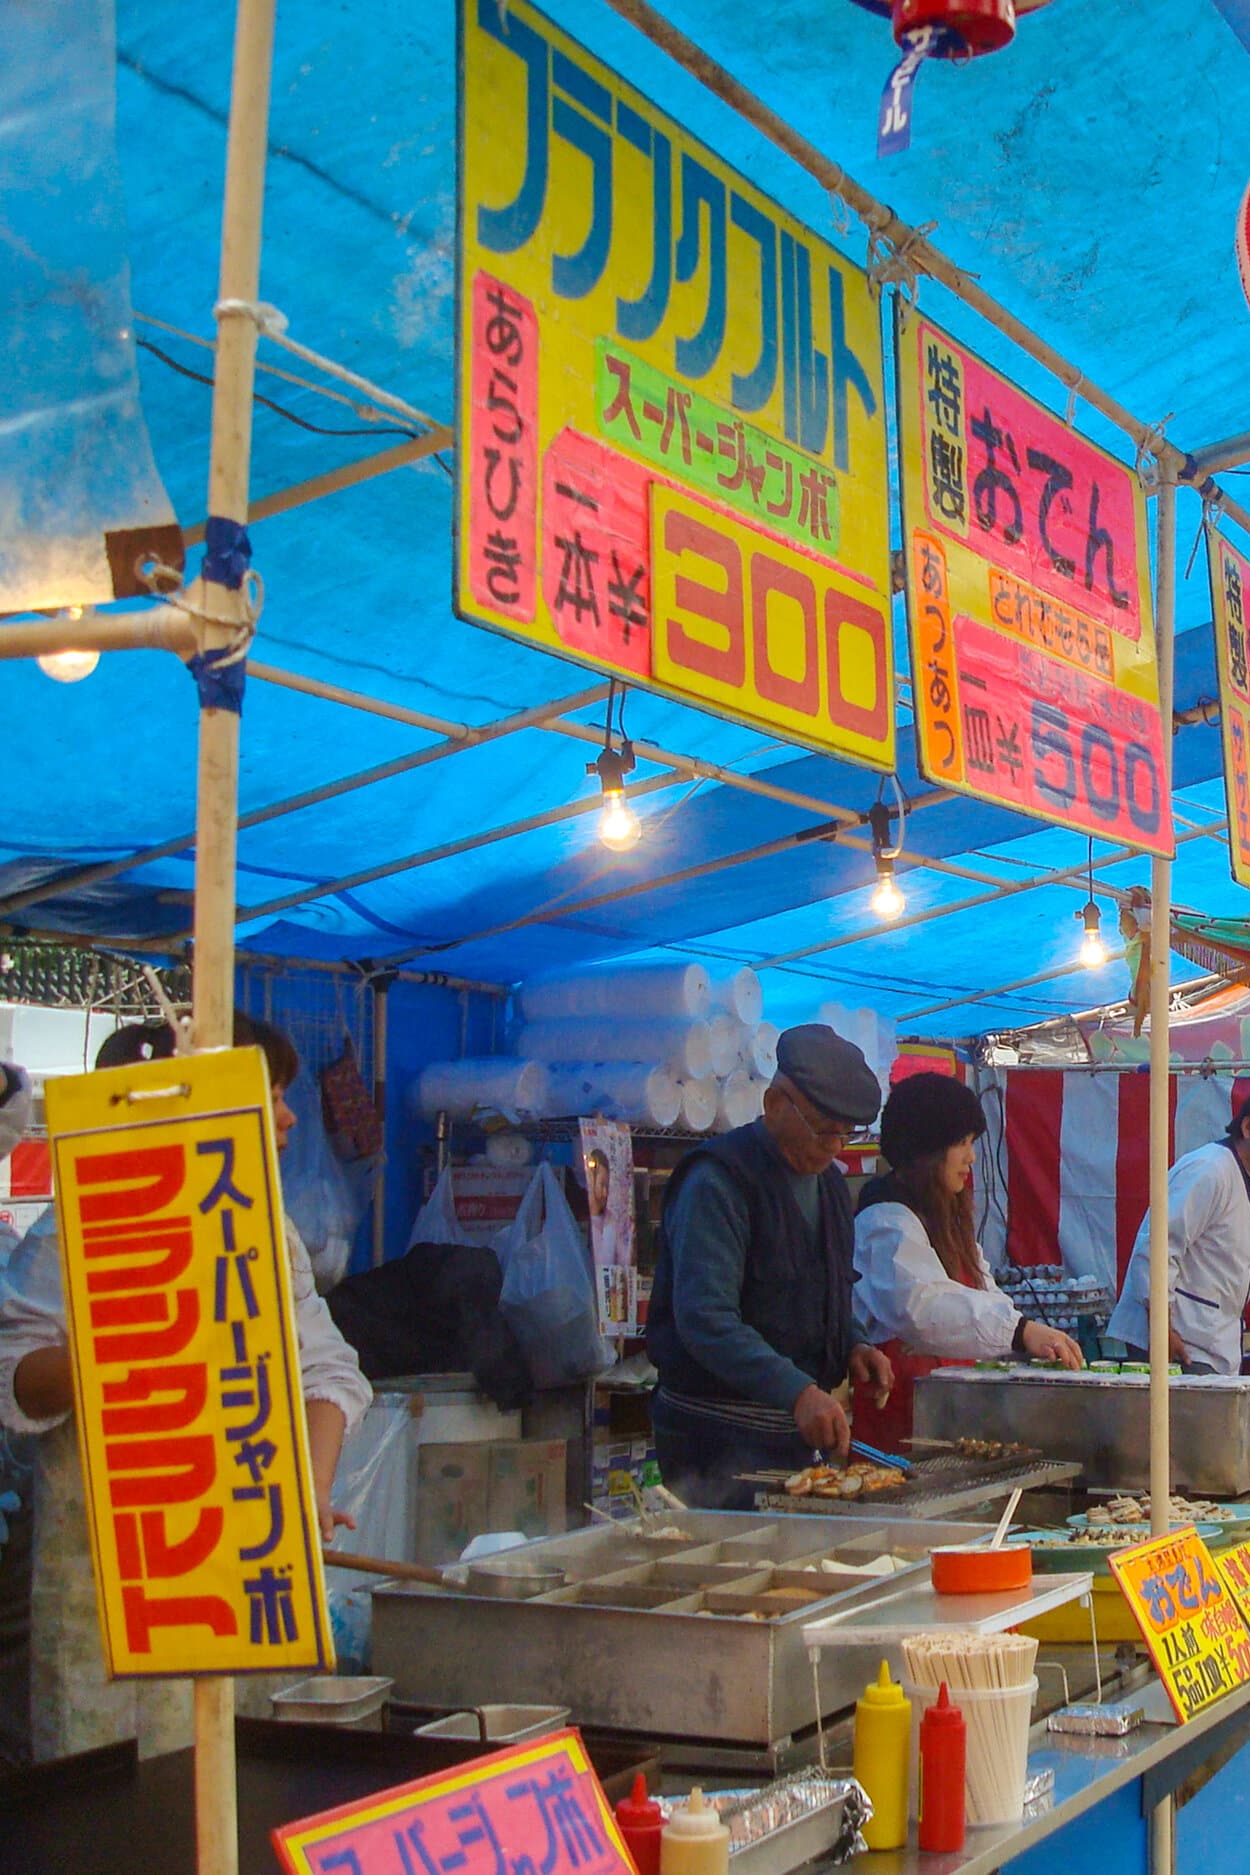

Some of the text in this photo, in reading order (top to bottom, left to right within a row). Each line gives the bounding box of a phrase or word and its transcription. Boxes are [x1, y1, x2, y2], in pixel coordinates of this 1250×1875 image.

[477, 2, 876, 472] フランクフルト
[483, 287, 525, 603] あらびき
[605, 355, 837, 541] スーパージャンボ
[927, 343, 967, 527] 特製
[970, 407, 1129, 609] おでん
[553, 484, 602, 628] 一本
[919, 541, 956, 768] あつあつ
[74, 1144, 238, 1655] フランクフルト
[196, 1139, 300, 1647] スーパージャンボ
[1138, 1554, 1223, 1625] おでん
[1161, 1621, 1201, 1666] 1人前
